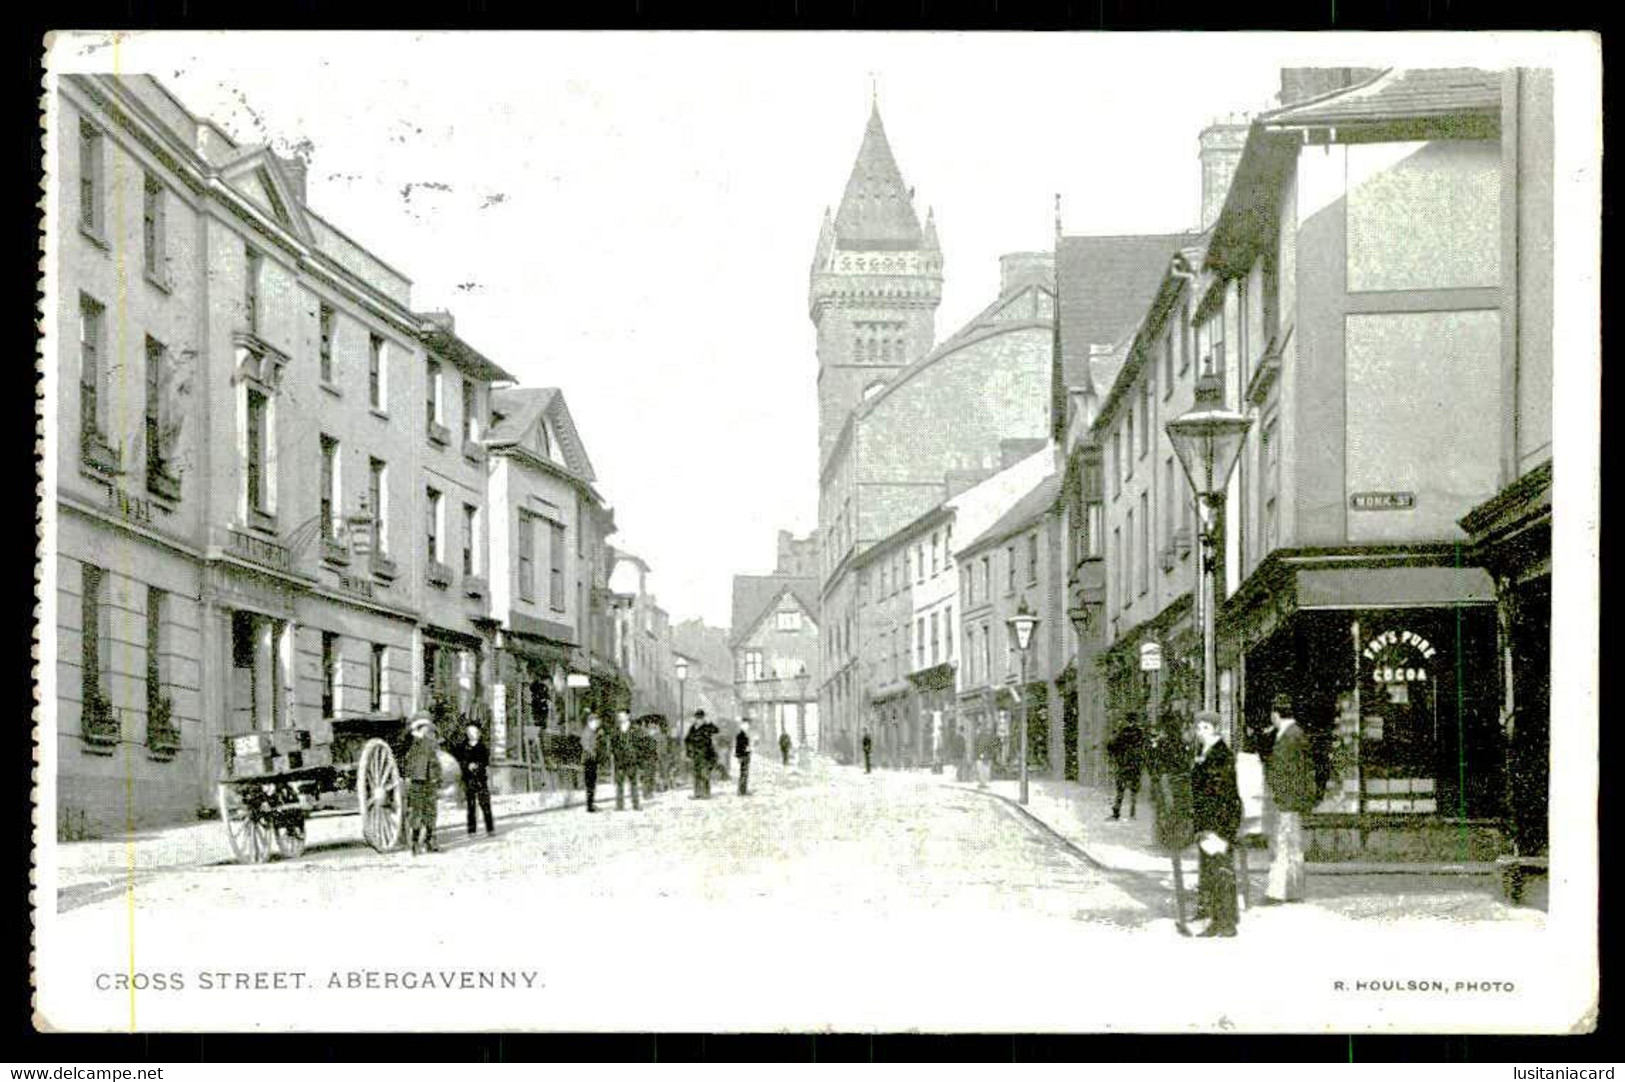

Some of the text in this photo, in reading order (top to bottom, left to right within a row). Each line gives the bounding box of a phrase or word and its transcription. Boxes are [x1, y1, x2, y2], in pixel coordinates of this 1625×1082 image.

[1401, 630, 1437, 660] PURE
[1373, 667, 1427, 682] COCOA
[95, 970, 546, 991] CROSS STREET. ABERGAVENNY.
[1333, 979, 1515, 994] R. HOULSON, PHOTO
